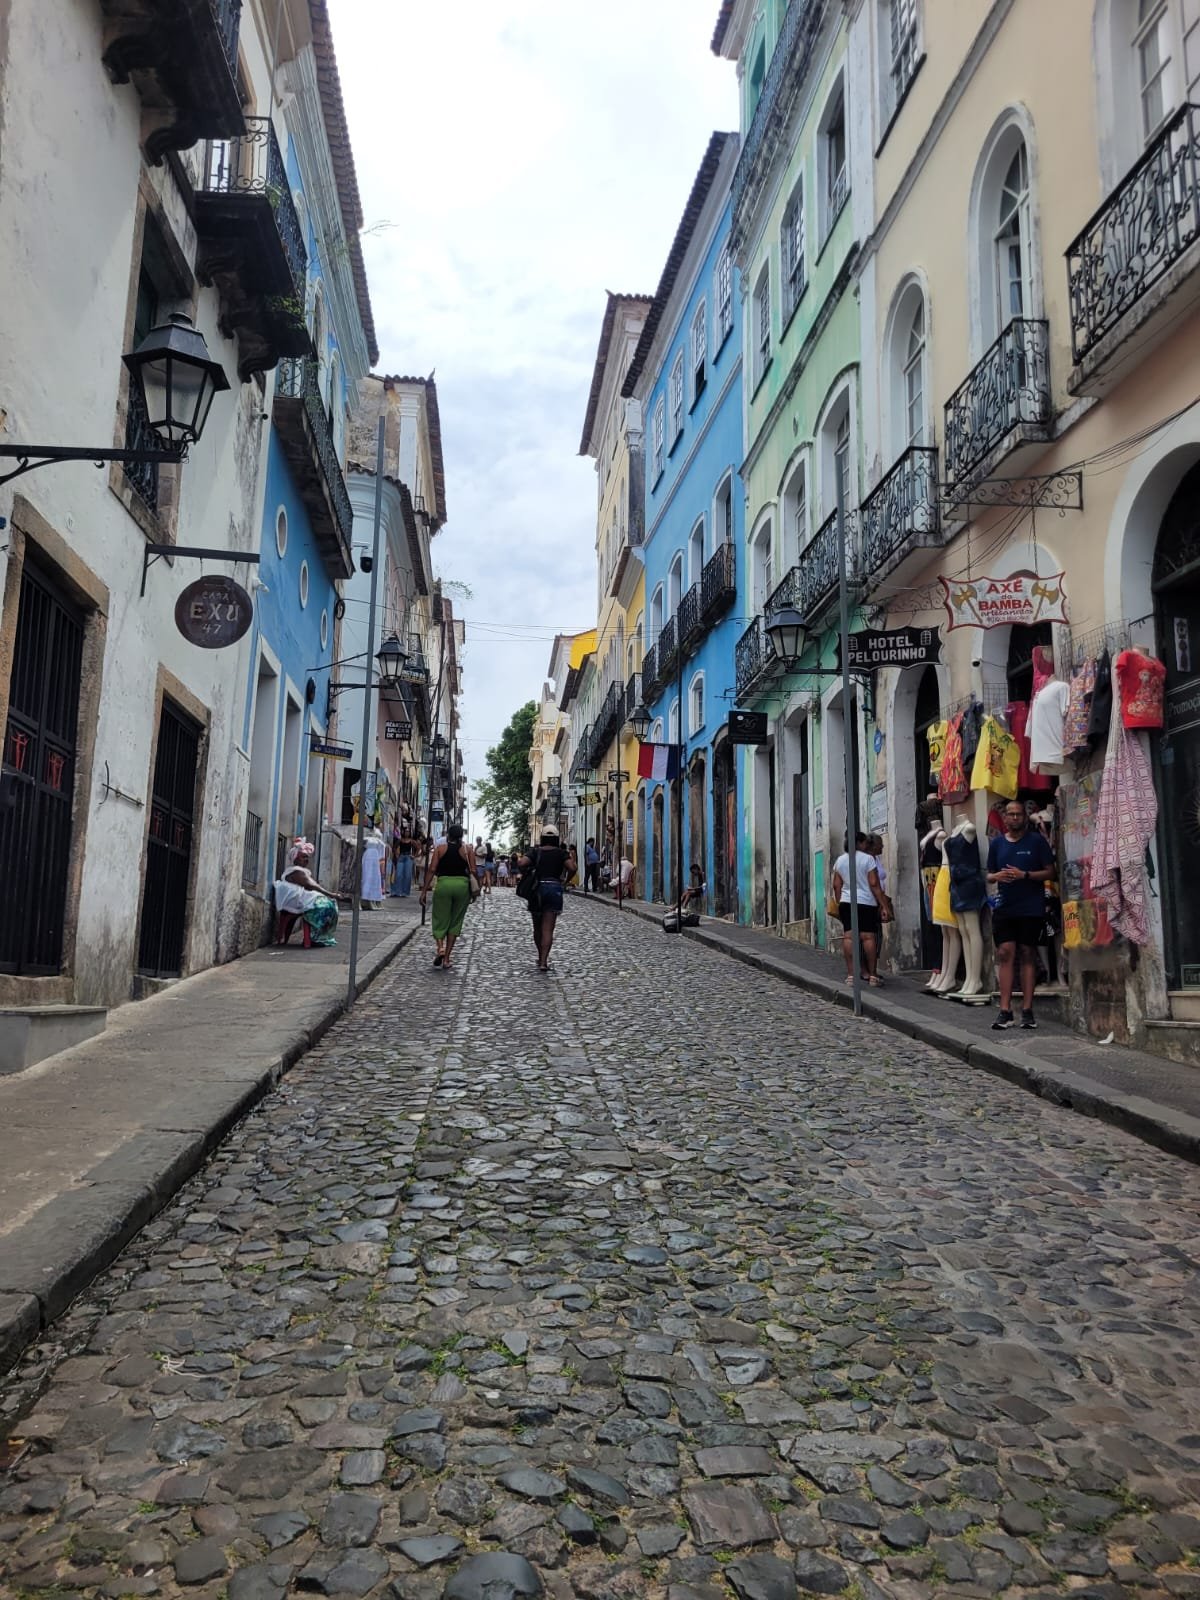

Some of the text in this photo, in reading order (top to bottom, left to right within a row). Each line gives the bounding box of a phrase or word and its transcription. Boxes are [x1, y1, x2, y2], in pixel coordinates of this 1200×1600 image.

[986, 577, 1023, 594] AXÉ
[978, 598, 1034, 611] BAMBA
[201, 623, 222, 634] 47
[868, 635, 914, 649] HOTEL
[848, 647, 926, 664] PELOURINHO
